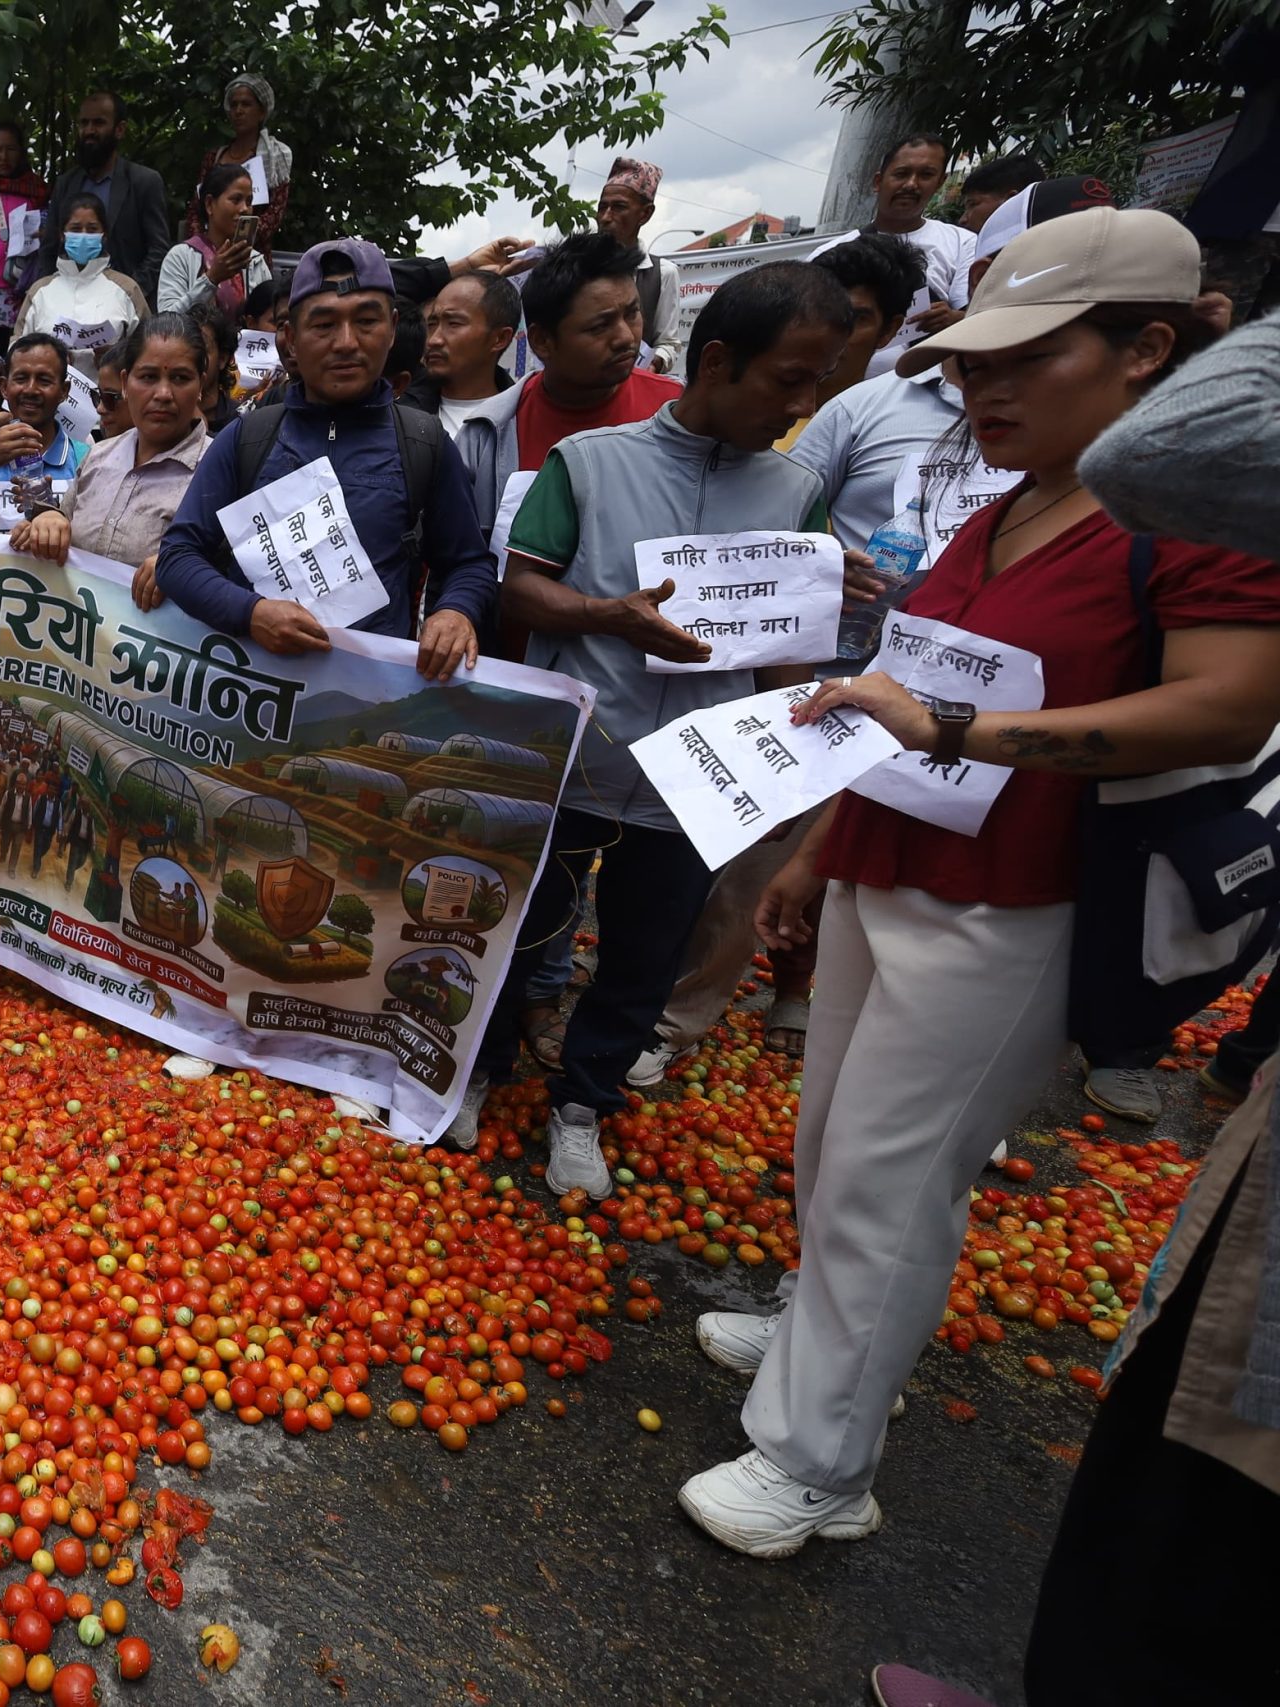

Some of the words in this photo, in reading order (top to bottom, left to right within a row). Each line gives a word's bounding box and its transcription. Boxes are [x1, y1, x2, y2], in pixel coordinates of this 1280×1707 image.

[245, 338, 270, 358] कृषि
[60, 415, 76, 432] गर।
[252, 511, 293, 593] व्यवस्थापन
[317, 493, 336, 519] एक
[342, 554, 364, 583] एक
[662, 544, 707, 567] बाहिर
[717, 538, 816, 563] तरकारीको
[300, 549, 331, 598] भण्डार
[697, 580, 778, 601] आयातमा
[760, 616, 800, 634] गर।
[110, 622, 306, 743] क्रान्ति
[80, 679, 233, 768] REVOLUTION
[733, 715, 771, 736] सही
[756, 732, 799, 775] बजार
[678, 725, 738, 792] व्यवस्थापन
[733, 791, 765, 827] गर।
[437, 872, 468, 884] POLICY
[1224, 856, 1268, 885] FASHION
[0, 896, 27, 915] मूल्य
[0, 930, 22, 950] हाम्रो
[24, 941, 66, 972] पसिनाको
[68, 962, 97, 985] उचित
[98, 974, 127, 996] मूल्य
[51, 915, 121, 960] बिचौलियाको
[125, 951, 151, 973] खेल
[263, 998, 322, 1015] सहुलियत
[414, 1008, 421, 1019] र
[252, 1011, 280, 1027] कृषि
[284, 1015, 326, 1030] क्षेत्रको
[412, 1060, 438, 1082] गर!
